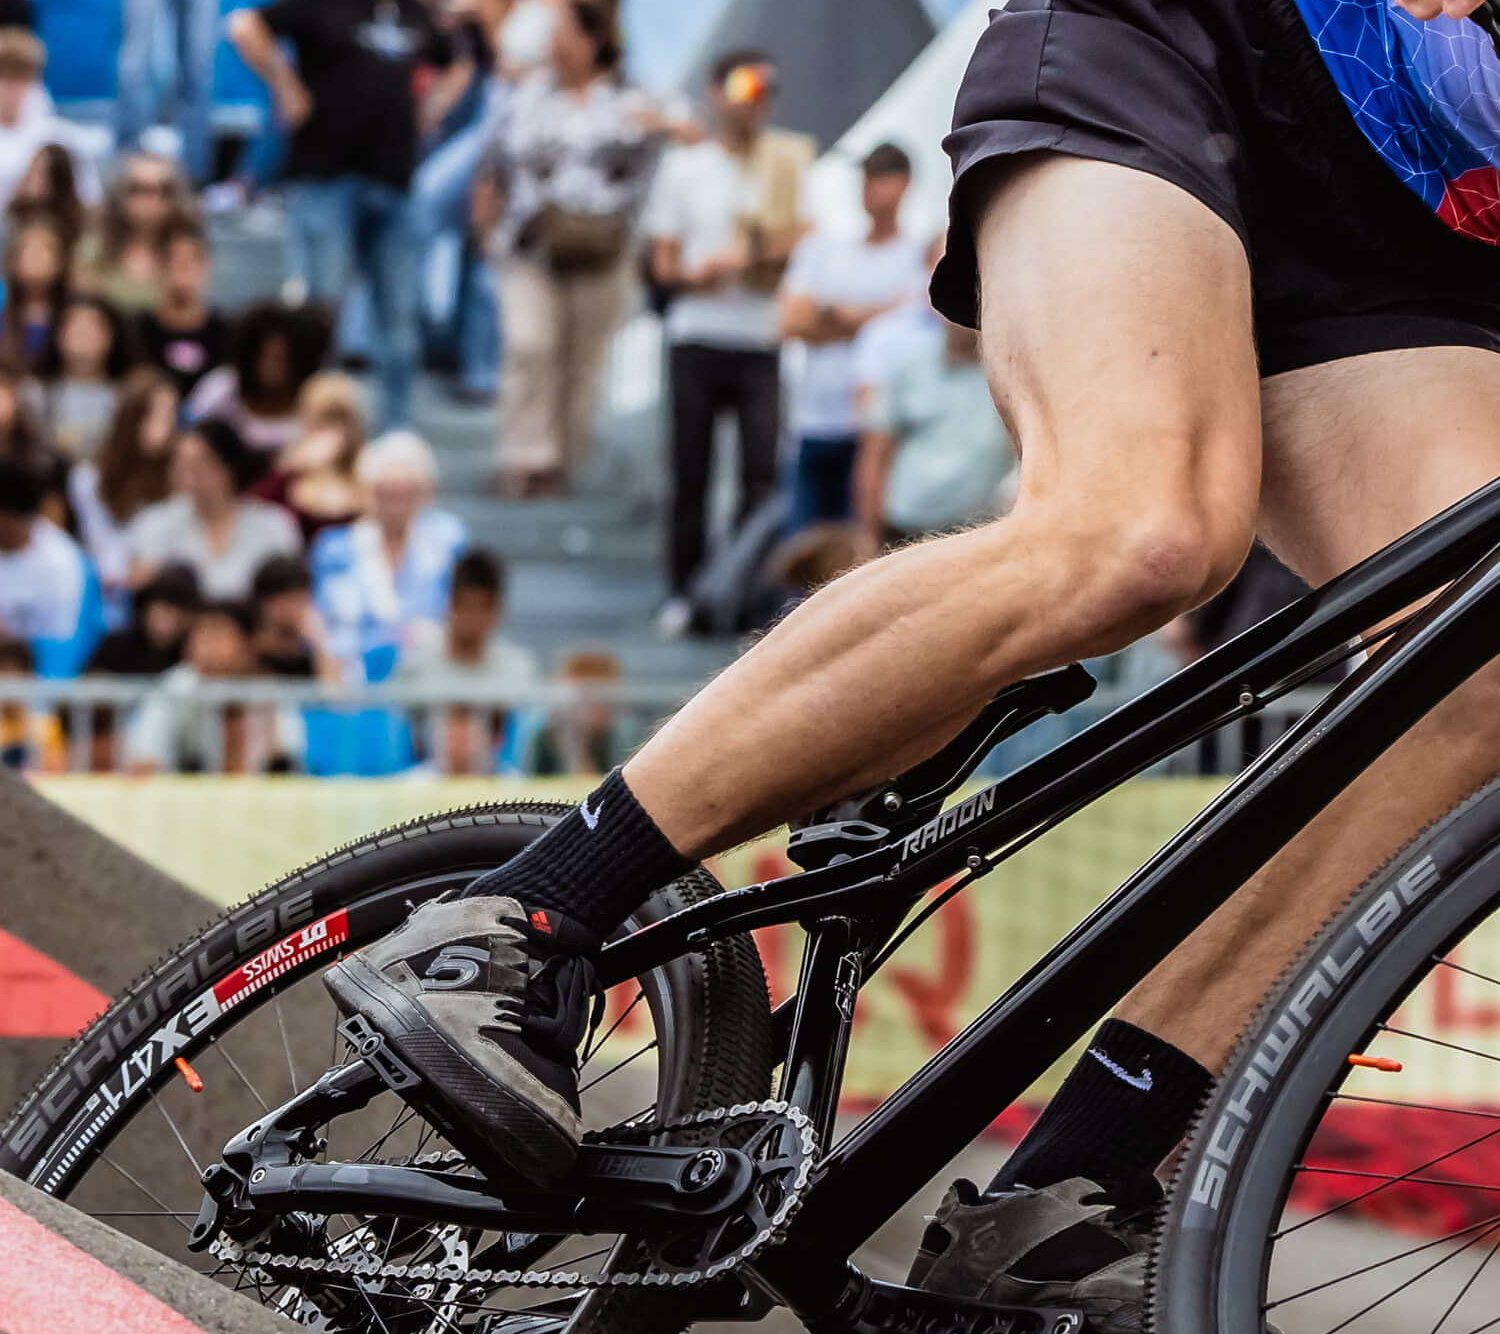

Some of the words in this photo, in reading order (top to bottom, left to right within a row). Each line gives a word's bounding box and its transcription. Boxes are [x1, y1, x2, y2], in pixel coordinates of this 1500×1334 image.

[901, 786, 997, 862] RADON
[241, 938, 295, 982] SWISS
[298, 919, 329, 949] DT
[9, 889, 314, 1163] SCHWALBE
[1190, 853, 1442, 1212] SCHWALBE
